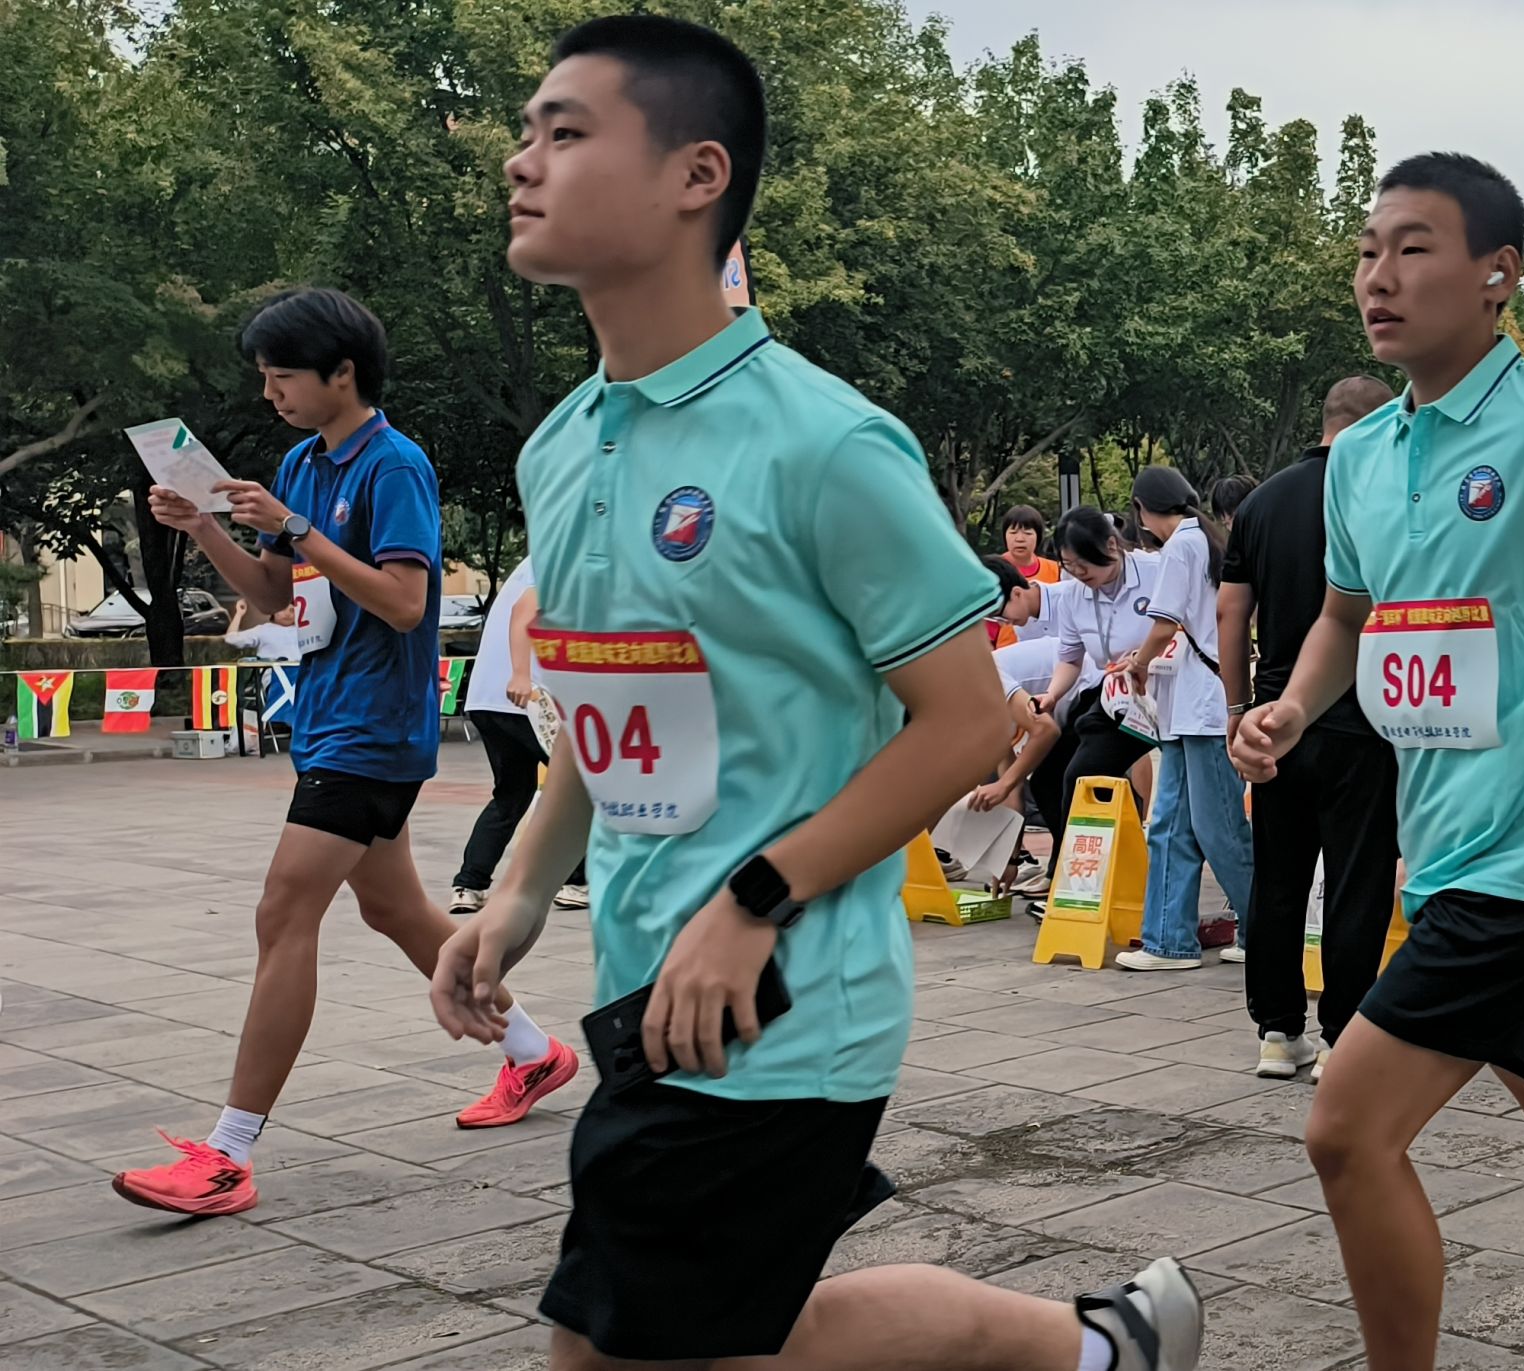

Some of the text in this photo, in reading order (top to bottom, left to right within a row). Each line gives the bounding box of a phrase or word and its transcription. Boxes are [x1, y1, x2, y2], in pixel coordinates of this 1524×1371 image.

[1383, 653, 1456, 707] S04
[554, 697, 662, 774] 04
[1073, 835, 1103, 855] 高职
[1068, 858, 1099, 877] 女子
